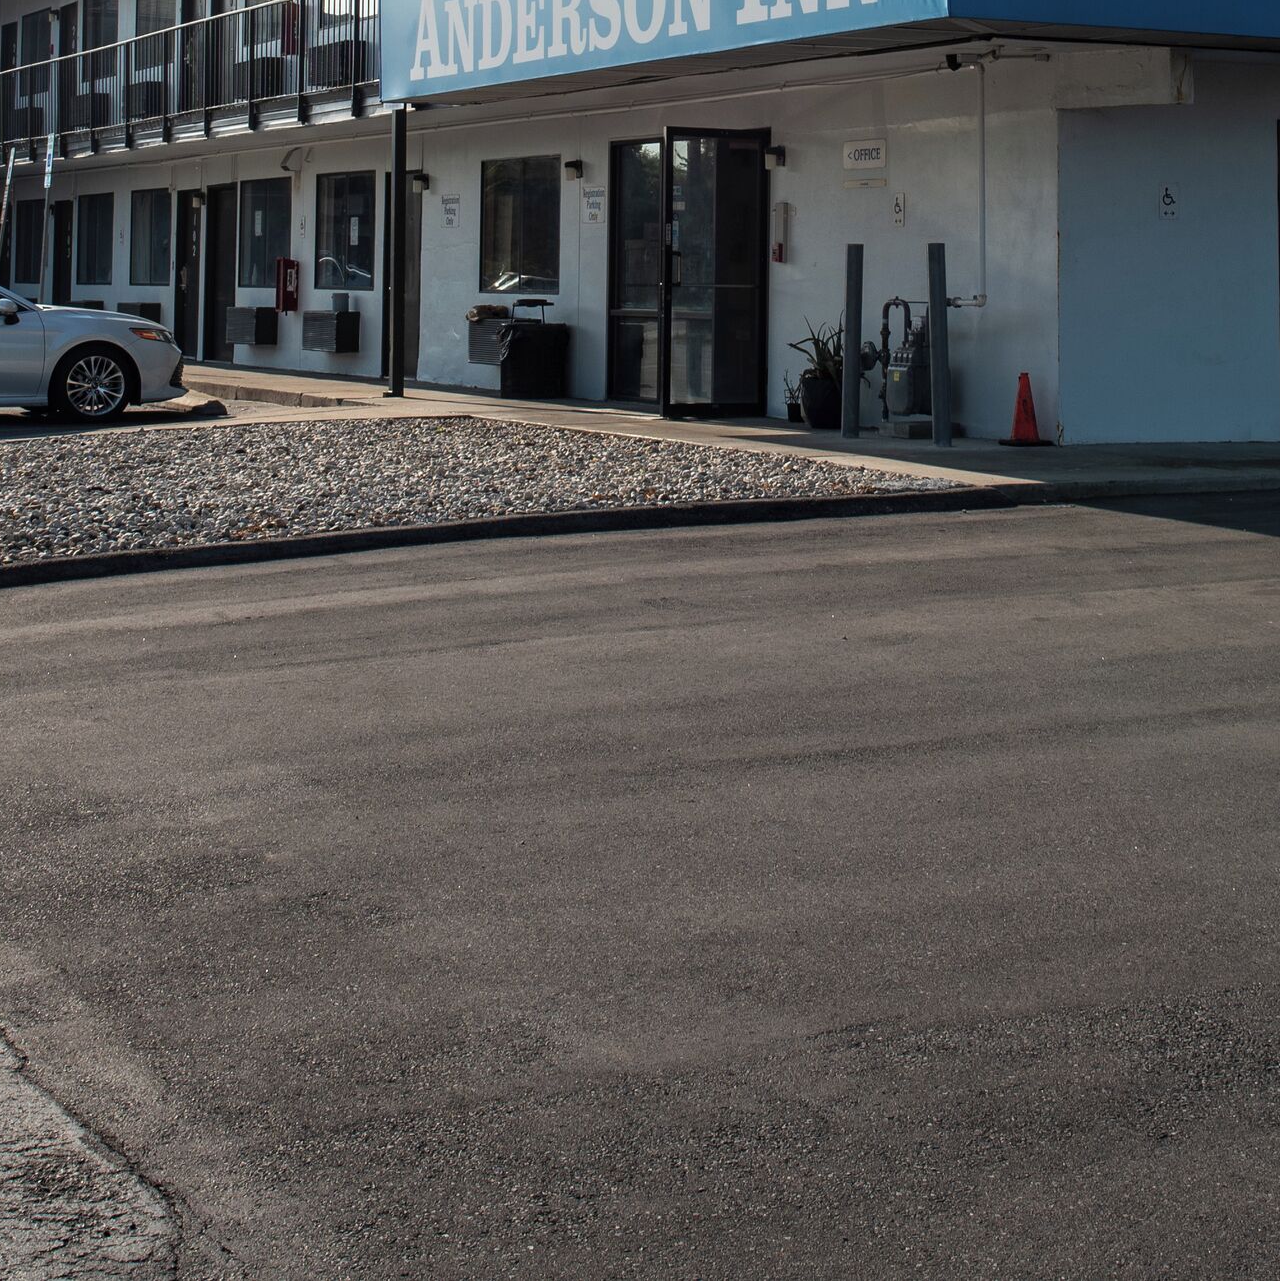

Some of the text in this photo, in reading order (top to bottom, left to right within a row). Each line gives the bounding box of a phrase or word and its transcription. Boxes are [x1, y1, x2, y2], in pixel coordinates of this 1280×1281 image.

[853, 147, 881, 161] OFFICE
[586, 200, 601, 211] Parking
[446, 217, 455, 227] Only
[588, 212, 598, 222] Only
